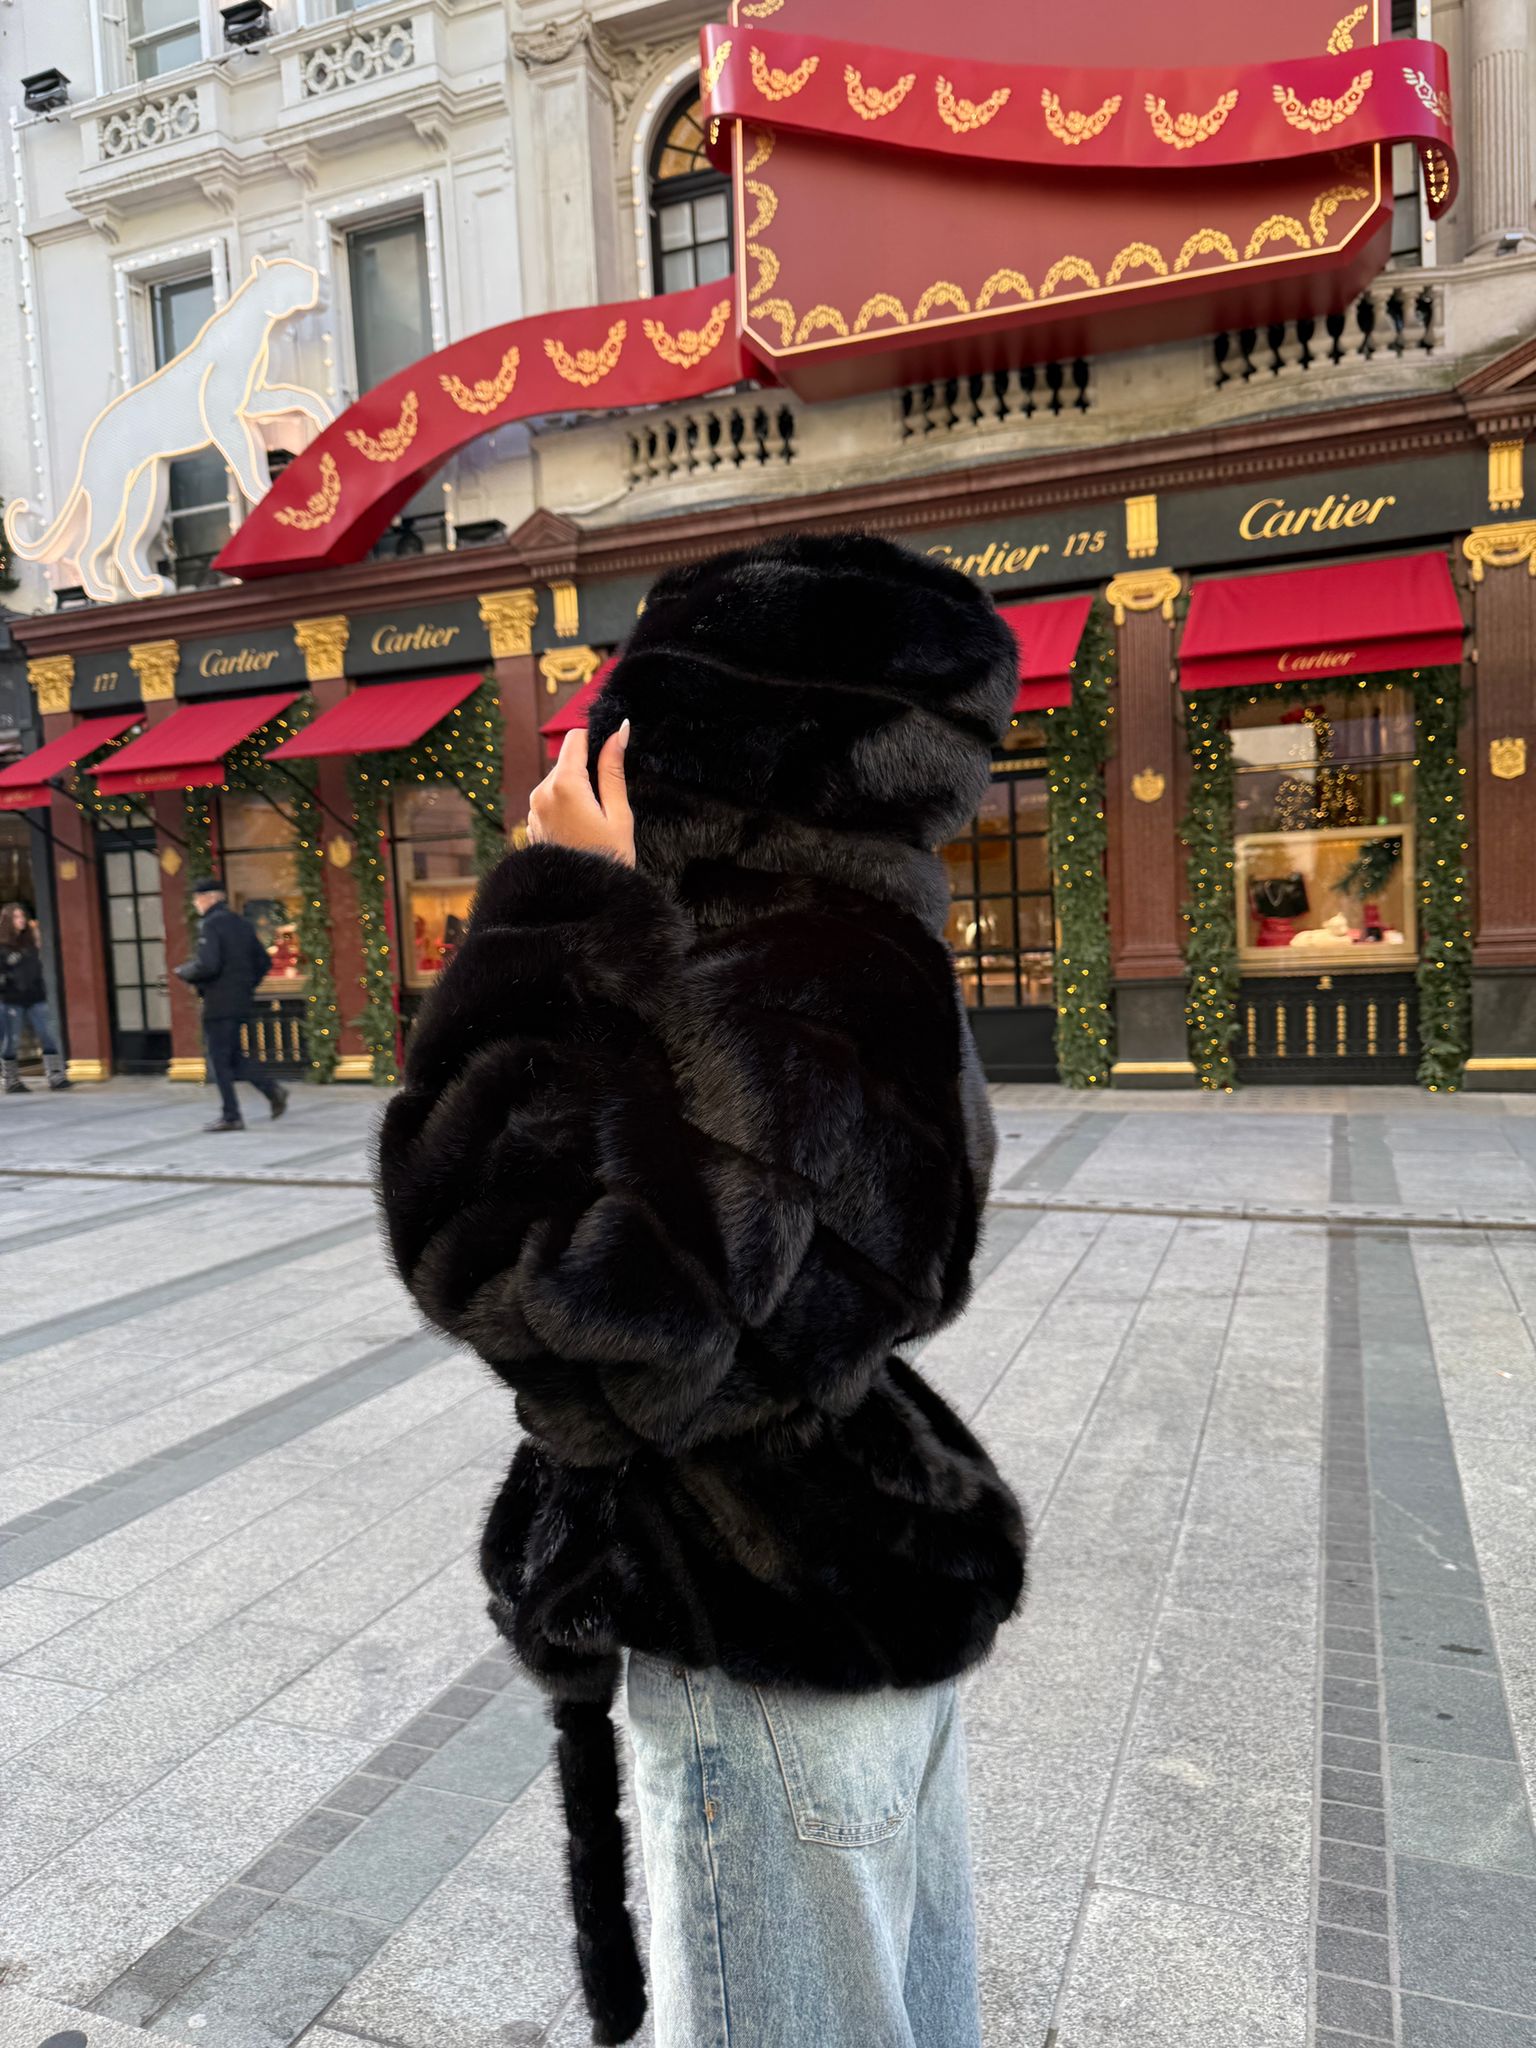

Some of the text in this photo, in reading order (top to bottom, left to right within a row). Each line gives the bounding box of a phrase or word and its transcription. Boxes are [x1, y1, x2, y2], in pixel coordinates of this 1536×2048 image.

[1239, 494, 1396, 540] Cartier
[1062, 530, 1108, 557] 175
[371, 625, 460, 655] Cartier
[200, 649, 279, 677] Cartier
[1277, 651, 1357, 672] Cartier
[93, 672, 118, 692] 177
